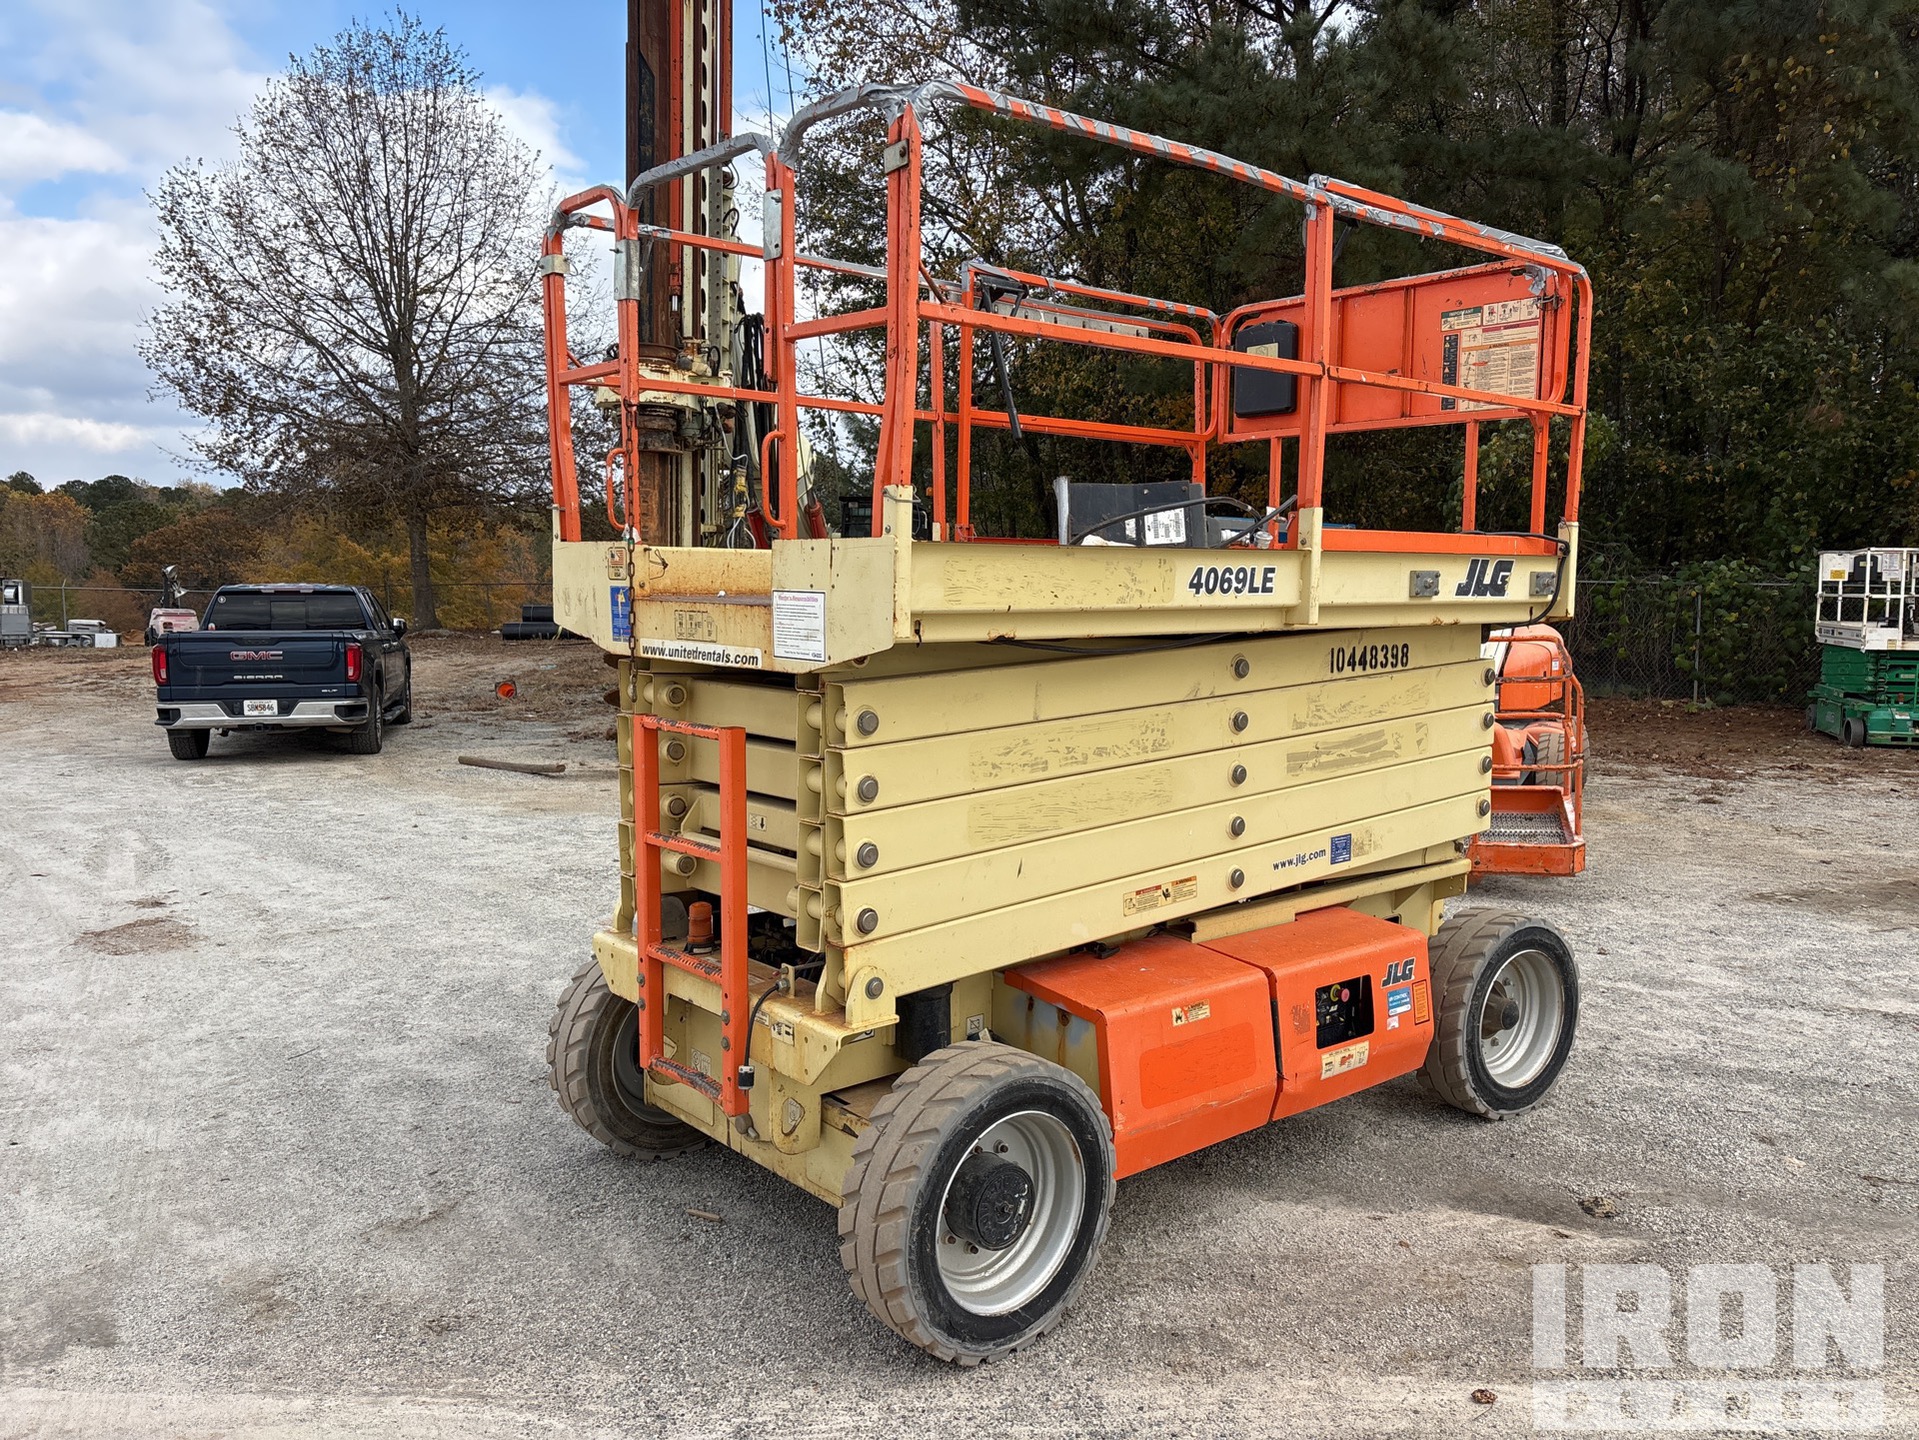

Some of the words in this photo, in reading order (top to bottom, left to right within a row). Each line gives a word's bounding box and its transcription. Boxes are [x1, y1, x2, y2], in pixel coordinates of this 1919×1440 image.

[1188, 566, 1277, 595] 4069LE
[1454, 558, 1515, 598] JLG
[230, 650, 283, 661] GMC
[642, 645, 759, 666] www.unitedrentals.com
[1329, 643, 1410, 674] 10448398
[1272, 849, 1326, 871] www.jlg.com
[1381, 957, 1415, 988] JLG
